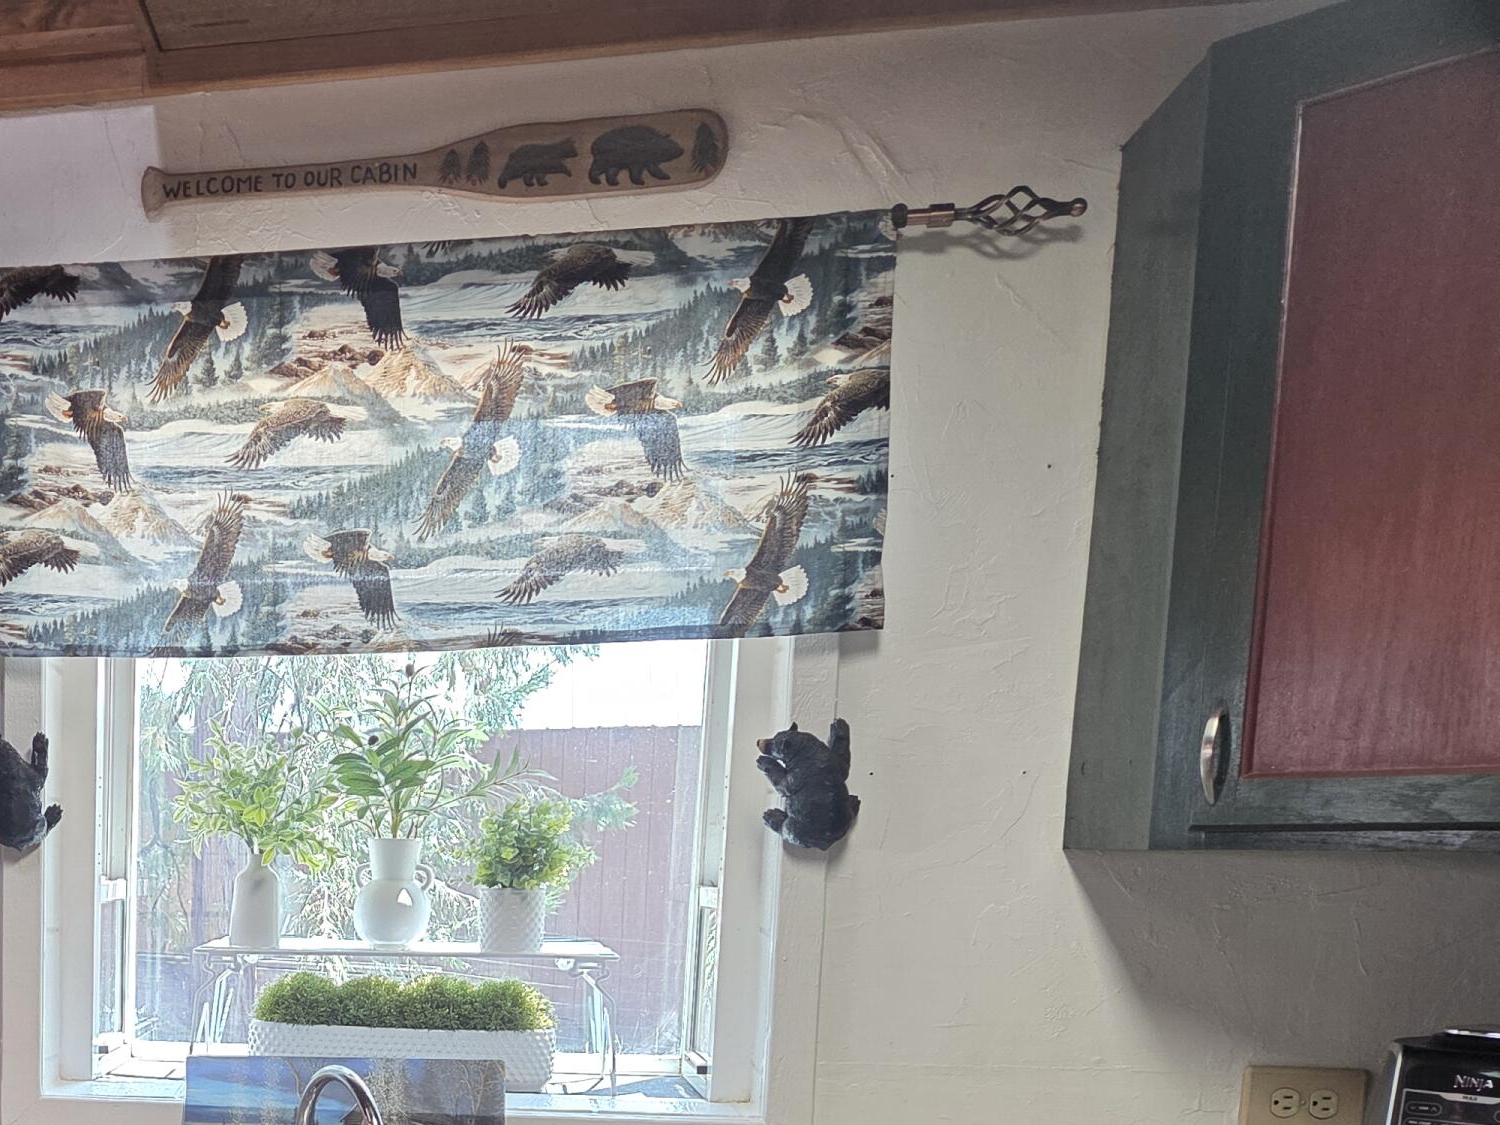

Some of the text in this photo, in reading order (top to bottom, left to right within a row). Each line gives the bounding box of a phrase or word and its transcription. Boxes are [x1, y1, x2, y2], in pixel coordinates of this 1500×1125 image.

[162, 162, 418, 199] WELCOME TO OUR CABIN
[1453, 1074, 1494, 1092] NINJA
